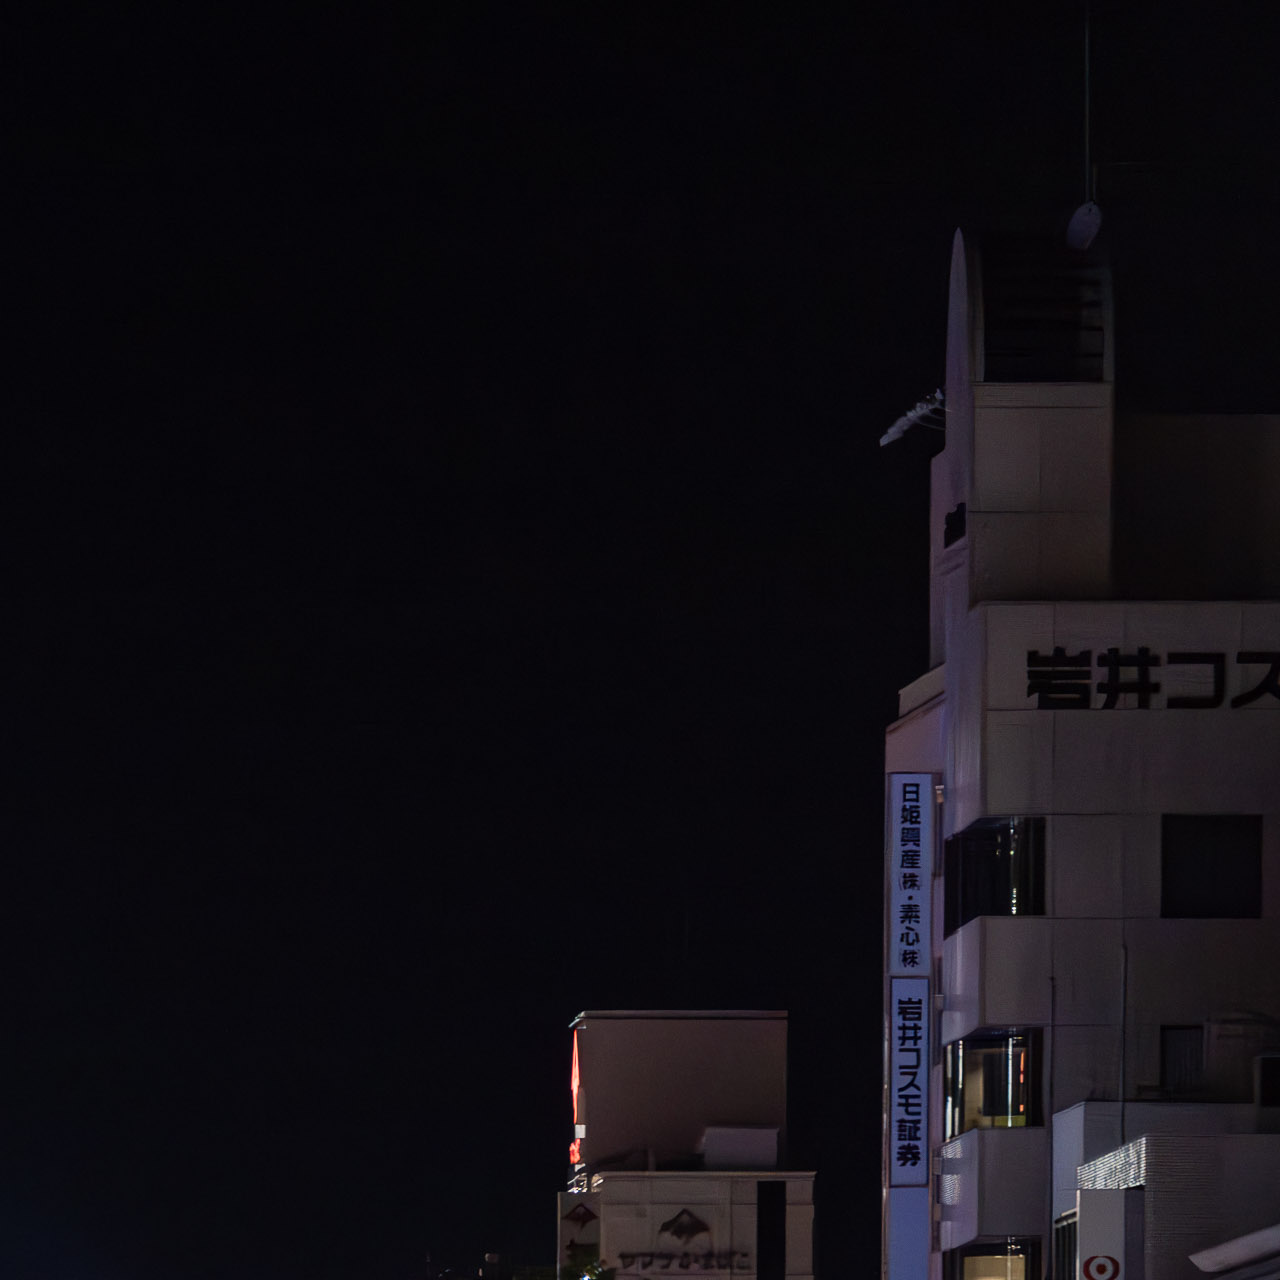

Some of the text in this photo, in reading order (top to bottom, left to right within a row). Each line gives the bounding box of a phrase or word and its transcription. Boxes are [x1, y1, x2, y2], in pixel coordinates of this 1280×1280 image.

[1027, 646, 1280, 710] 岩井コス
[896, 996, 923, 1168] 岩井コスモ証券
